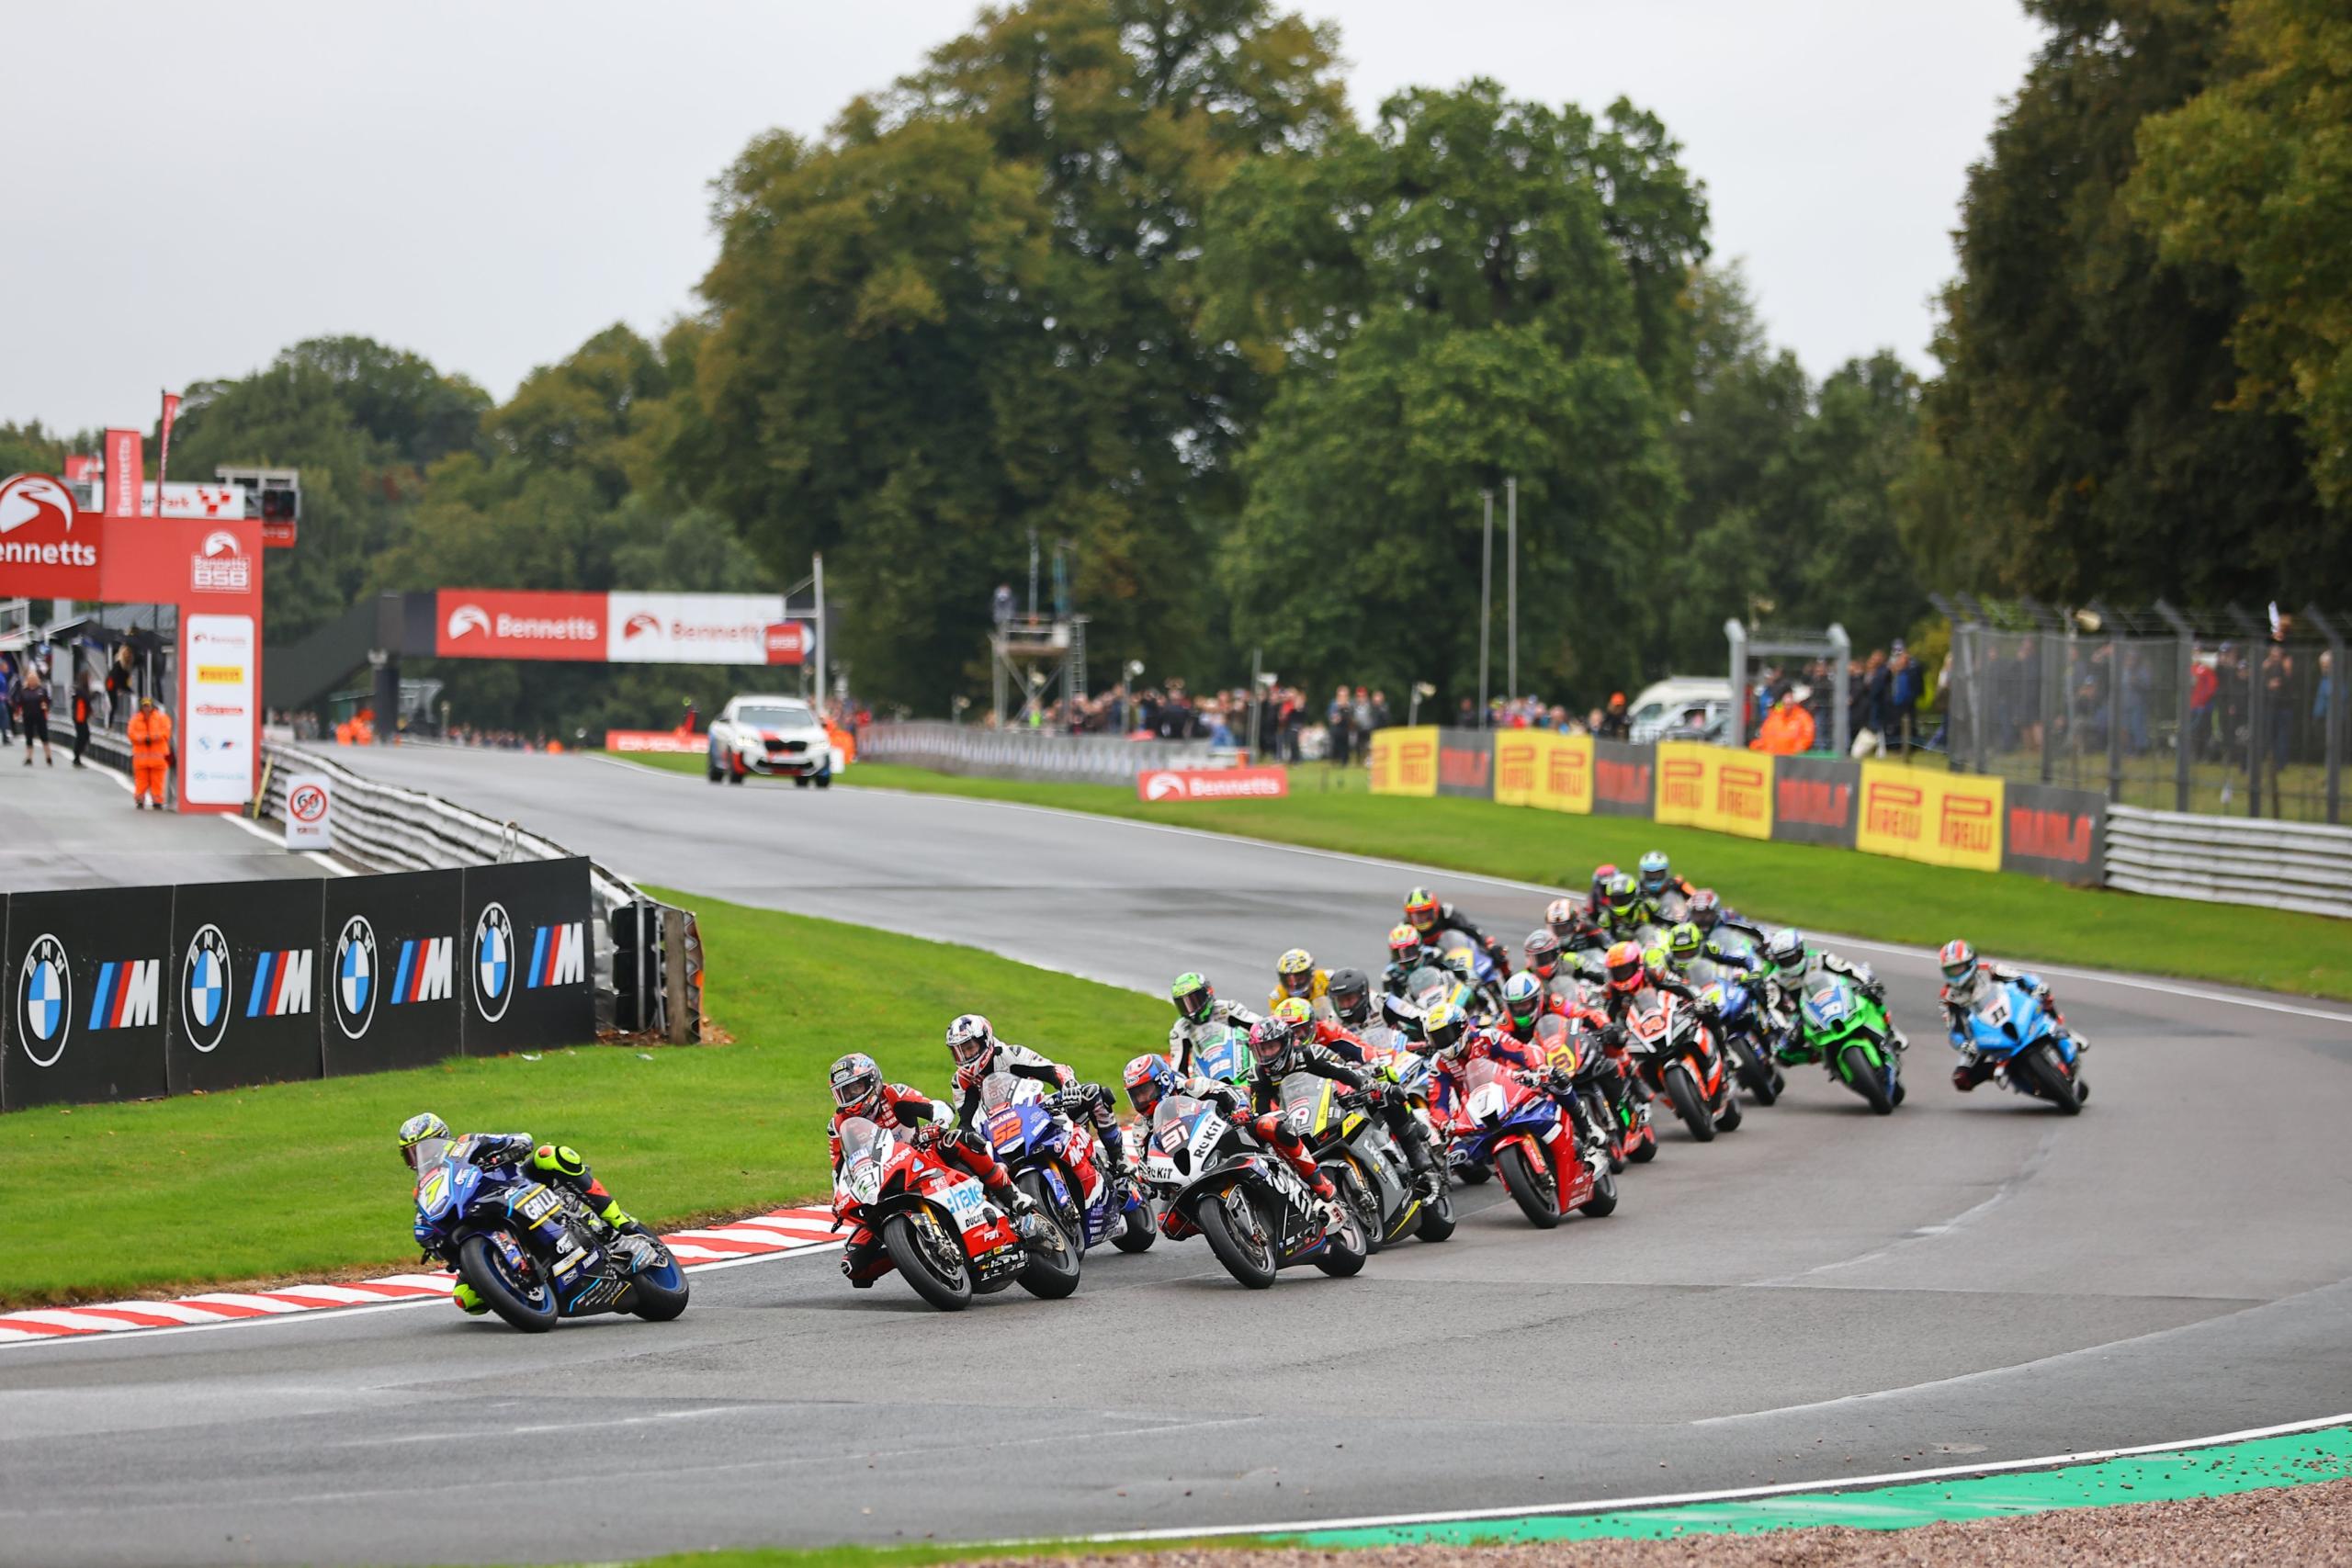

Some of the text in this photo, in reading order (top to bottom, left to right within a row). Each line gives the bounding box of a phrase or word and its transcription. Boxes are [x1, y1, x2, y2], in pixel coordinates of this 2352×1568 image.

[497, 613, 598, 640] Bennetts
[1190, 777, 1280, 796] Bennetts
[1866, 782, 1922, 841] PIRELLI
[1939, 794, 1992, 852] PIRELLI
[993, 1118, 1022, 1147] 52
[1161, 1123, 1190, 1155] 91
